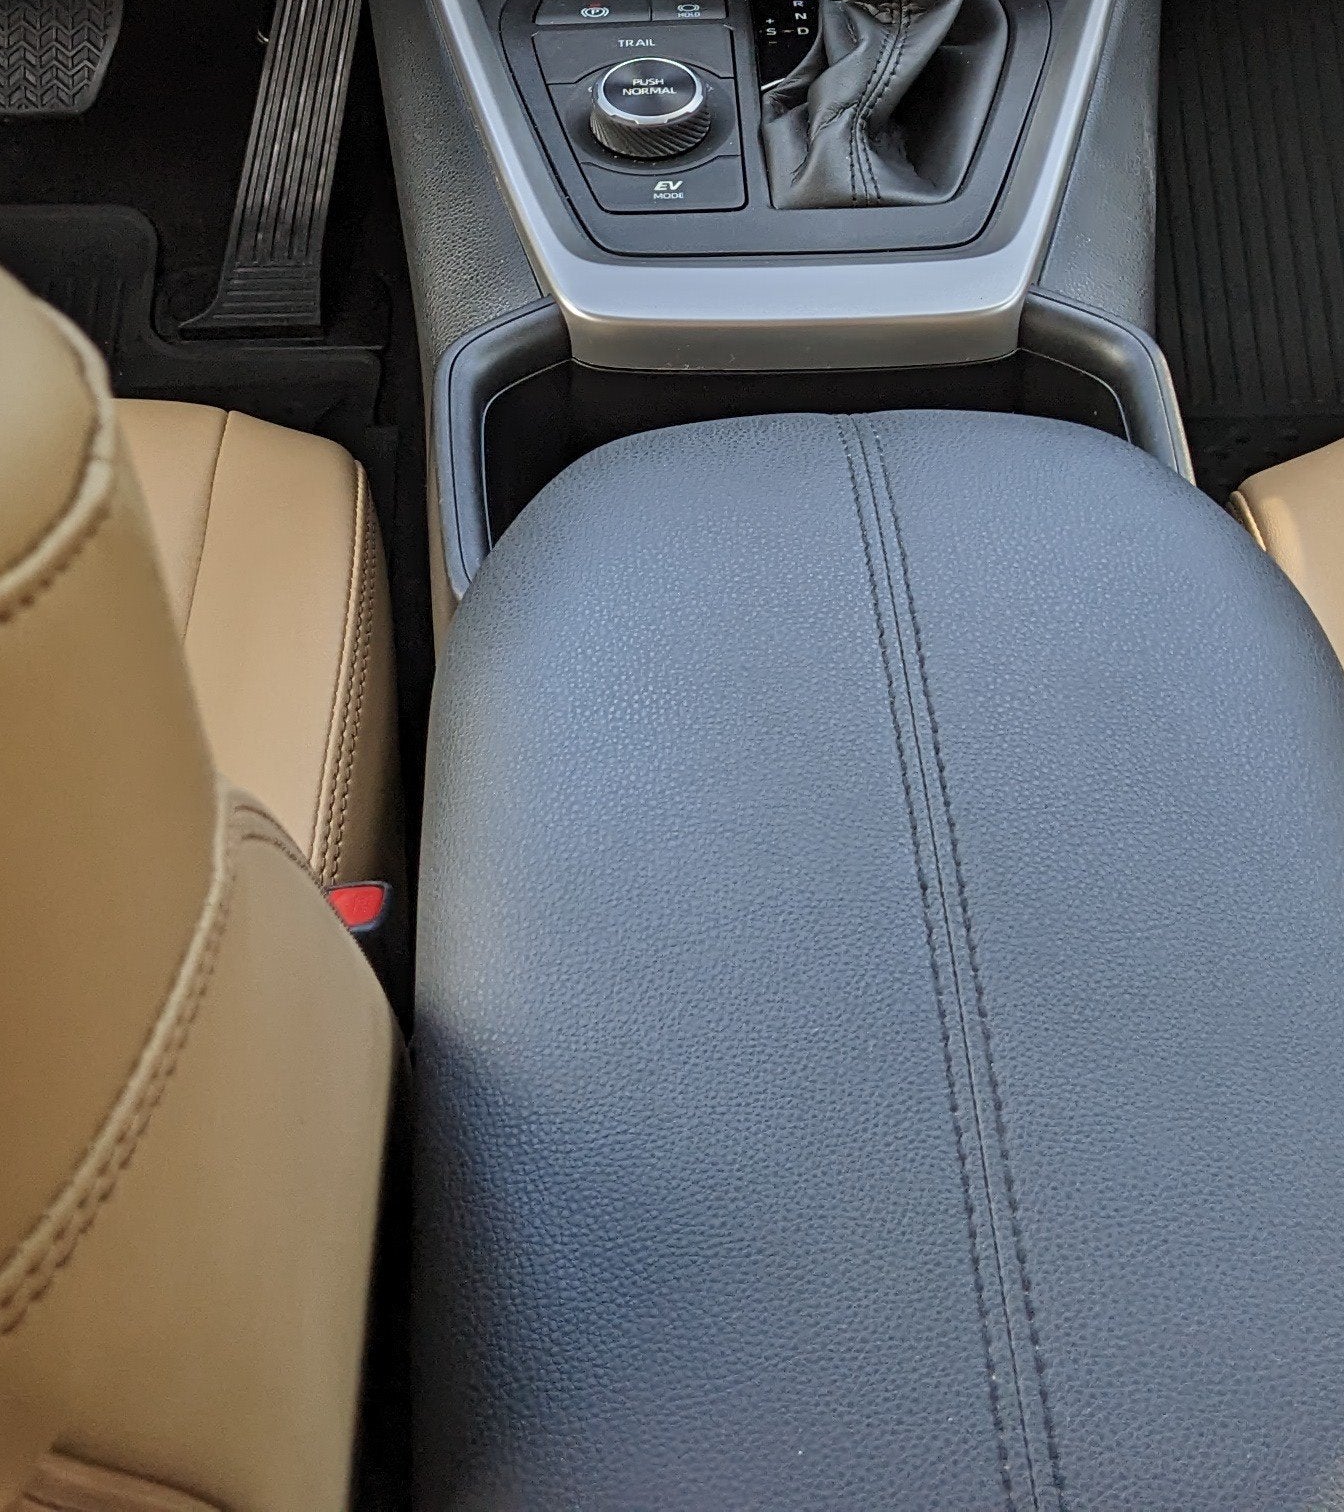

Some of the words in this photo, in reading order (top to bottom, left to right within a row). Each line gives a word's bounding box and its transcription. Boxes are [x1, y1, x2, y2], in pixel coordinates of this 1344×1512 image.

[794, 12, 808, 20] N
[766, 27, 777, 36] S
[797, 27, 810, 35] D
[617, 38, 656, 47] TRAIL
[632, 78, 664, 86] PUSH
[622, 86, 677, 96] NORMAL
[653, 180, 683, 191] EV
[653, 192, 684, 200] MODE
